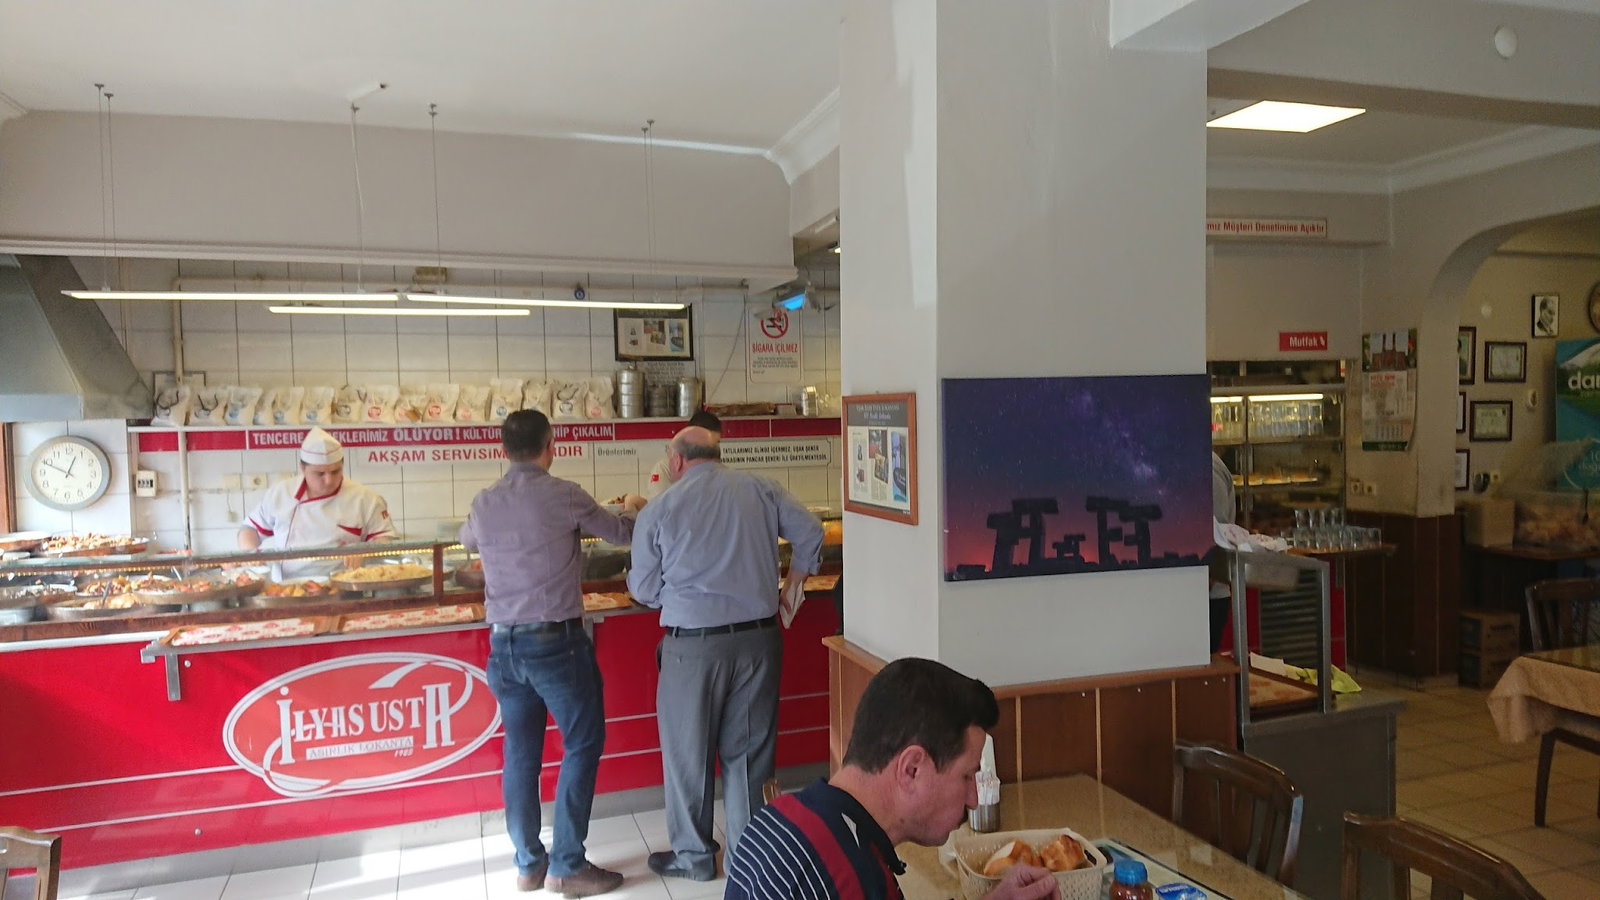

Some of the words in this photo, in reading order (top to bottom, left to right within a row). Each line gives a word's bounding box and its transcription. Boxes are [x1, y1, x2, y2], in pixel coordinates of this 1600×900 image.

[1223, 221, 1253, 233] Müşteri
[752, 342, 774, 353] SİGARA
[775, 341, 799, 354] İÇİLMEZ
[1289, 336, 1318, 347] Mutfak
[253, 431, 305, 445] TENCERE
[572, 425, 613, 439] ÇIKALIM
[368, 449, 425, 464] AKŞAM
[597, 447, 636, 458] Ürünlerimiz
[276, 686, 366, 765] İLYAS
[369, 682, 457, 750] USTA
[309, 745, 357, 759] ASIRLIK
[360, 738, 413, 752] LOKANTA
